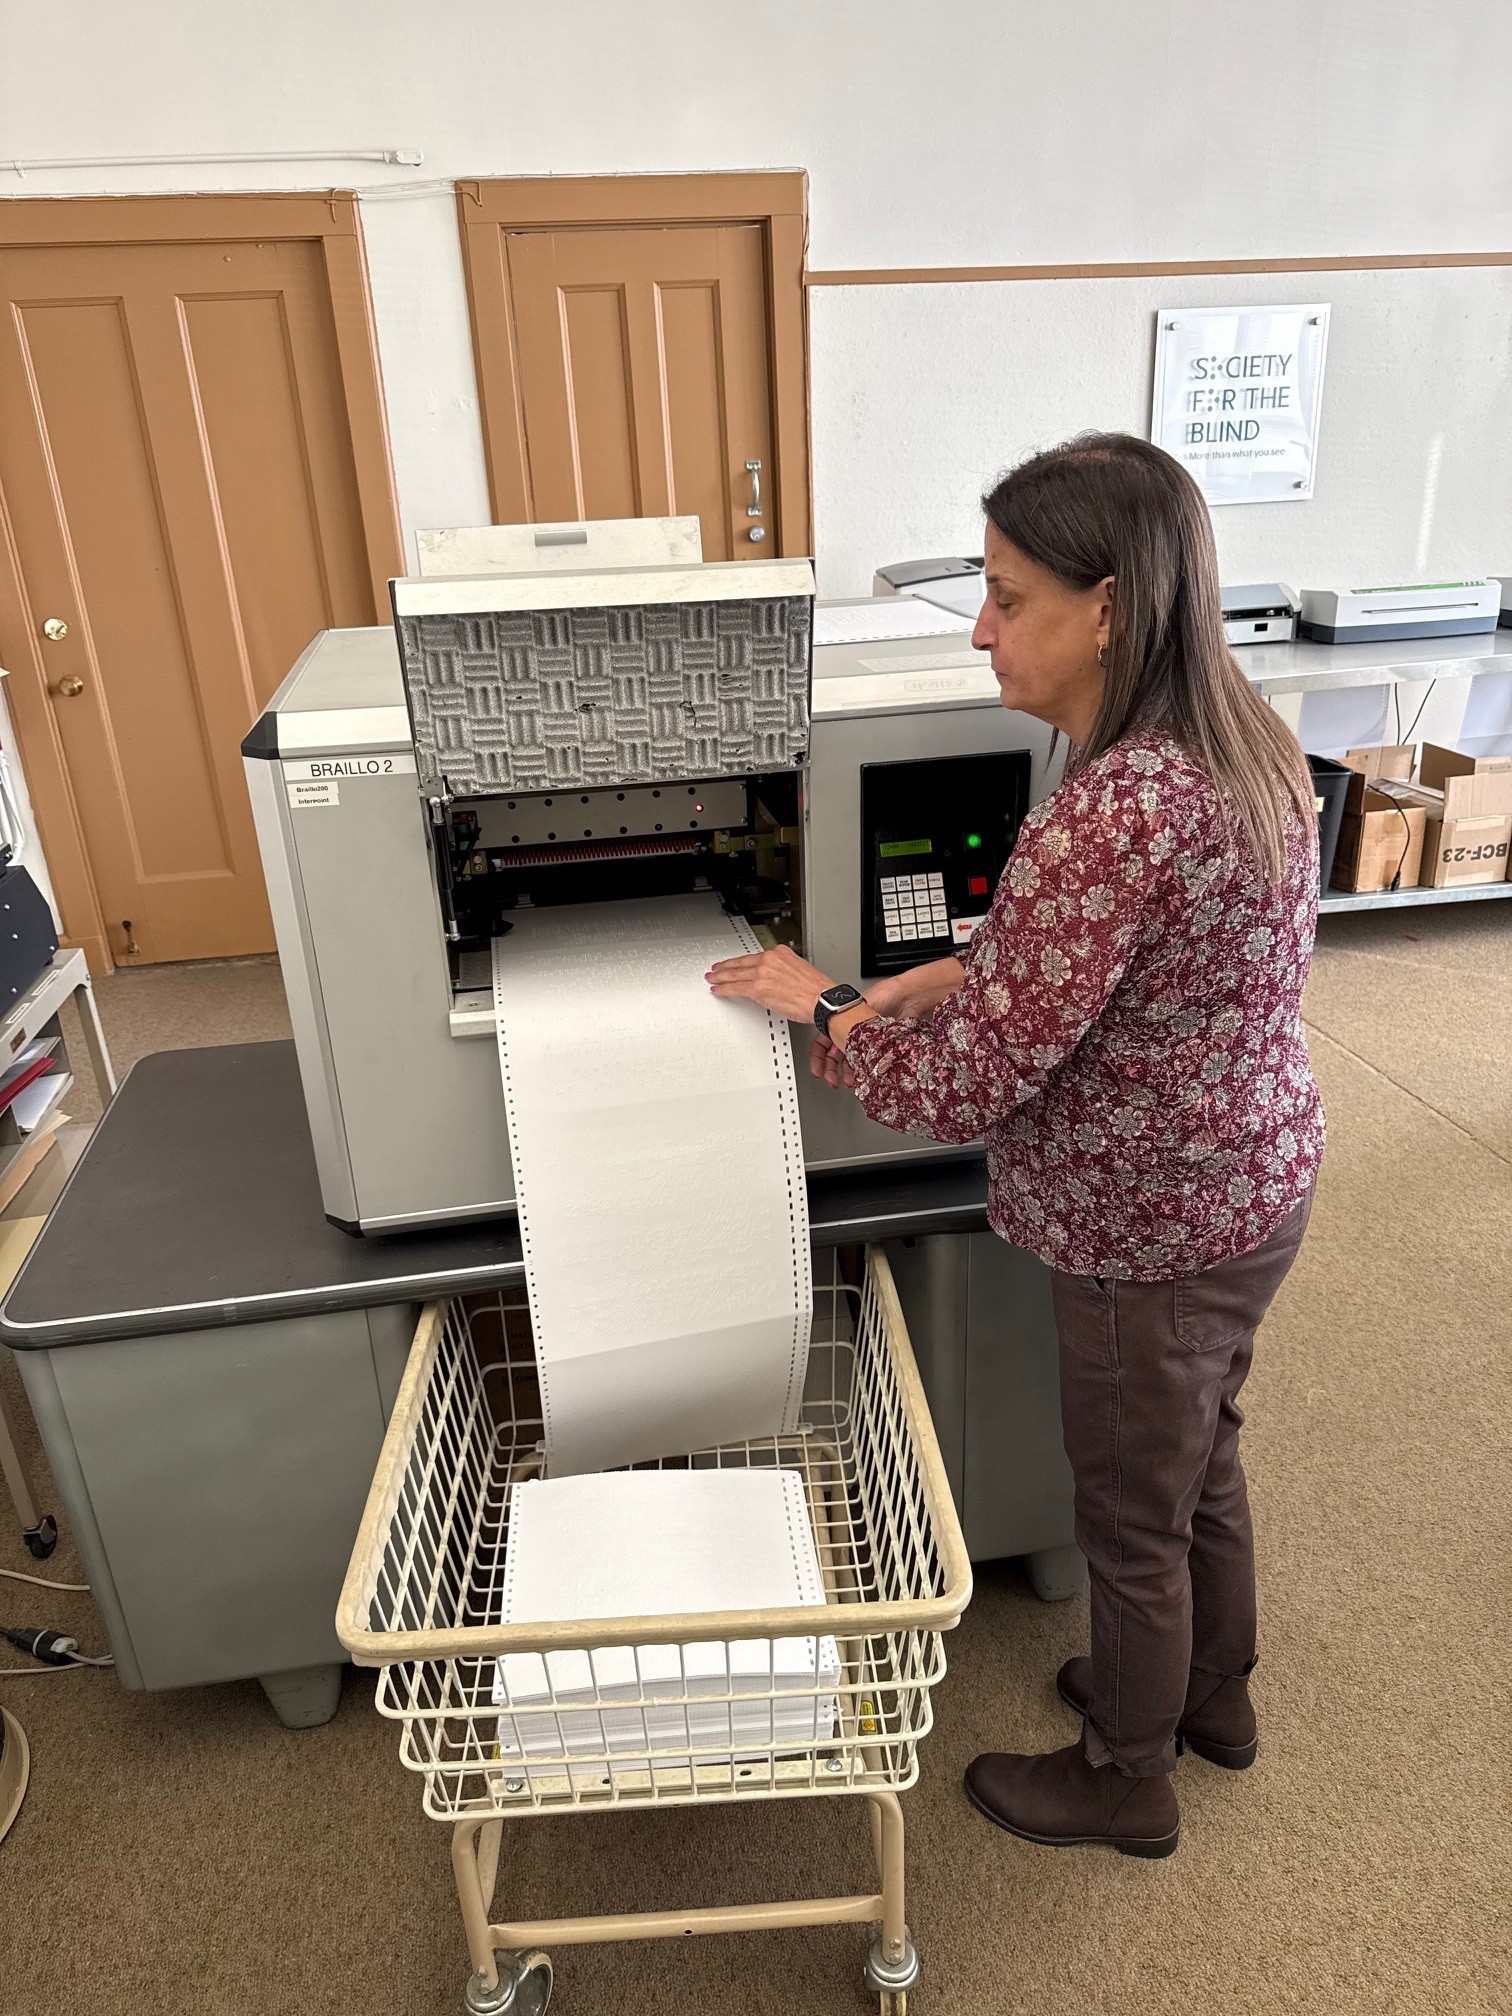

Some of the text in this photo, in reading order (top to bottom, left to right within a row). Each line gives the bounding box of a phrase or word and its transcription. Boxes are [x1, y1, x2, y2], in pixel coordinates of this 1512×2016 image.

[1246, 385, 1291, 410] THE
[1190, 419, 1260, 444] BLIND
[1189, 448, 1285, 460] More than what you see
[311, 760, 393, 776] BRAILLO 2
[298, 797, 330, 805] Interpoint
[1443, 842, 1507, 863] BCF-23
